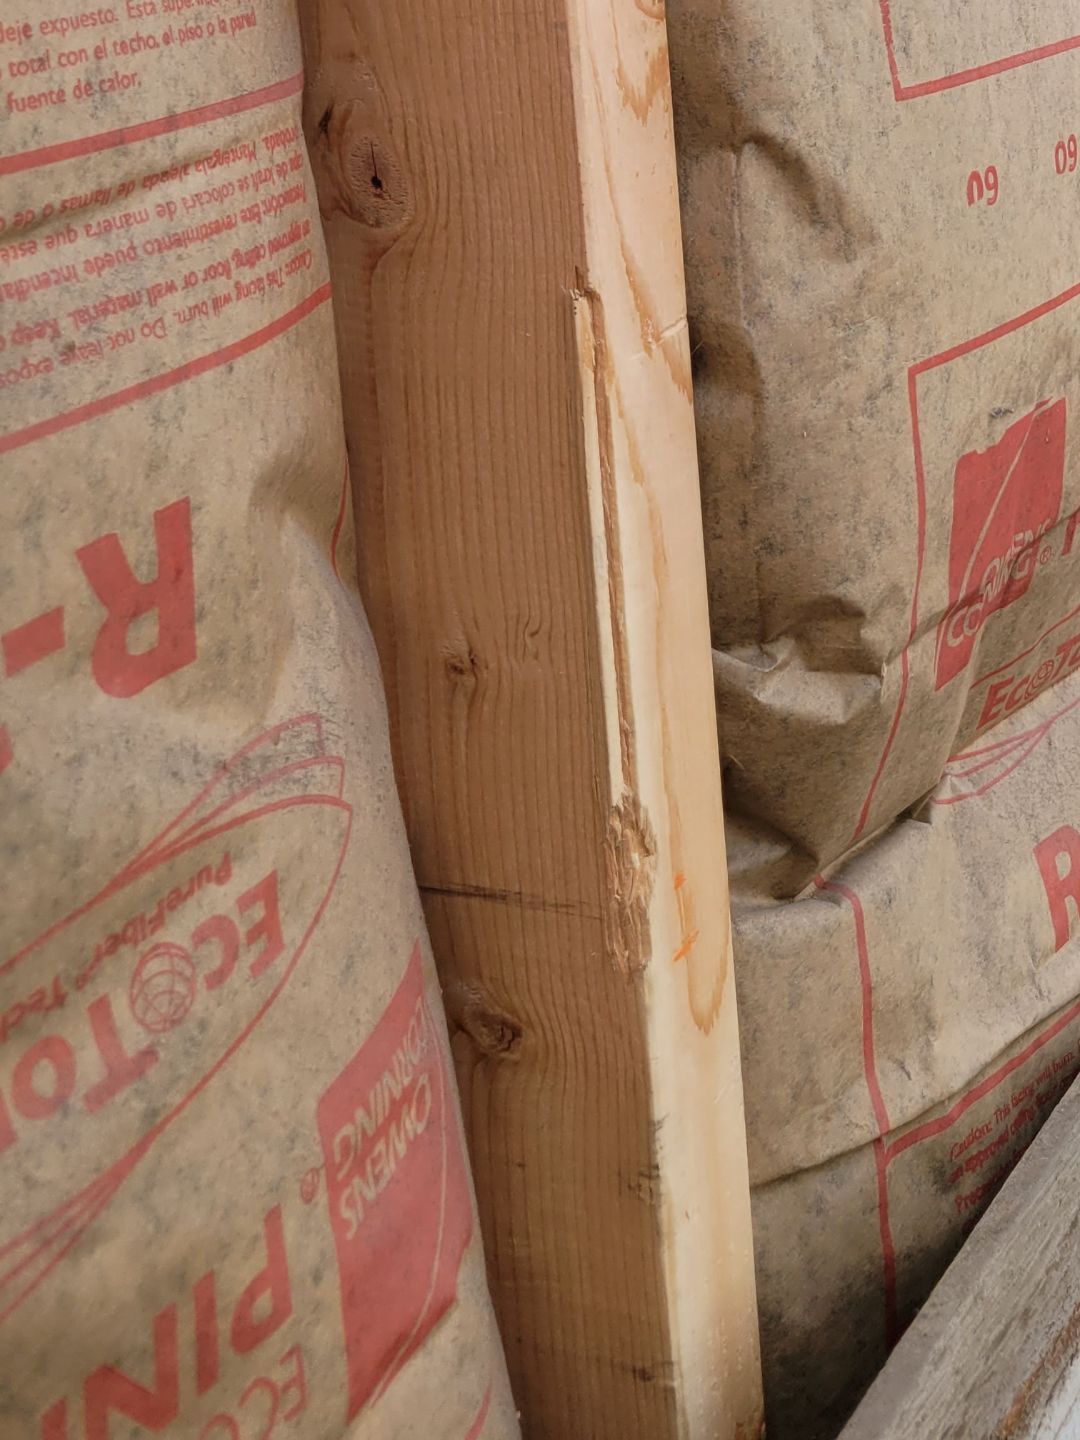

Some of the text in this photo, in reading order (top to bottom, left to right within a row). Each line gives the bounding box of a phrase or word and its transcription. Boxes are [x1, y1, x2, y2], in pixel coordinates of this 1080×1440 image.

[40, 8, 119, 38] expuesto.
[8, 48, 51, 78] total
[58, 48, 88, 68] con
[94, 38, 108, 60] el
[162, 24, 174, 46] el
[178, 22, 203, 48] piso
[206, 21, 215, 37] o
[217, 14, 228, 34] la
[7, 69, 142, 113] fuente de calor.
[1054, 133, 1078, 175] 09
[116, 180, 136, 198] de
[236, 176, 249, 192] se
[42, 203, 55, 218] o
[59, 187, 112, 214] llamas
[155, 200, 178, 222] de
[13, 209, 36, 229] de
[83, 207, 149, 238] manera
[44, 221, 79, 249] que
[83, 239, 138, 277] puede
[202, 258, 233, 282] floor
[146, 279, 178, 308] wall
[182, 271, 199, 291] or
[211, 292, 233, 316] will
[10, 318, 62, 347] Keep
[106, 327, 136, 351] not
[140, 316, 167, 340] Do
[58, 339, 104, 366] leave
[339, 1074, 432, 1241] OWENS
[41, 1203, 293, 1440] PIN
